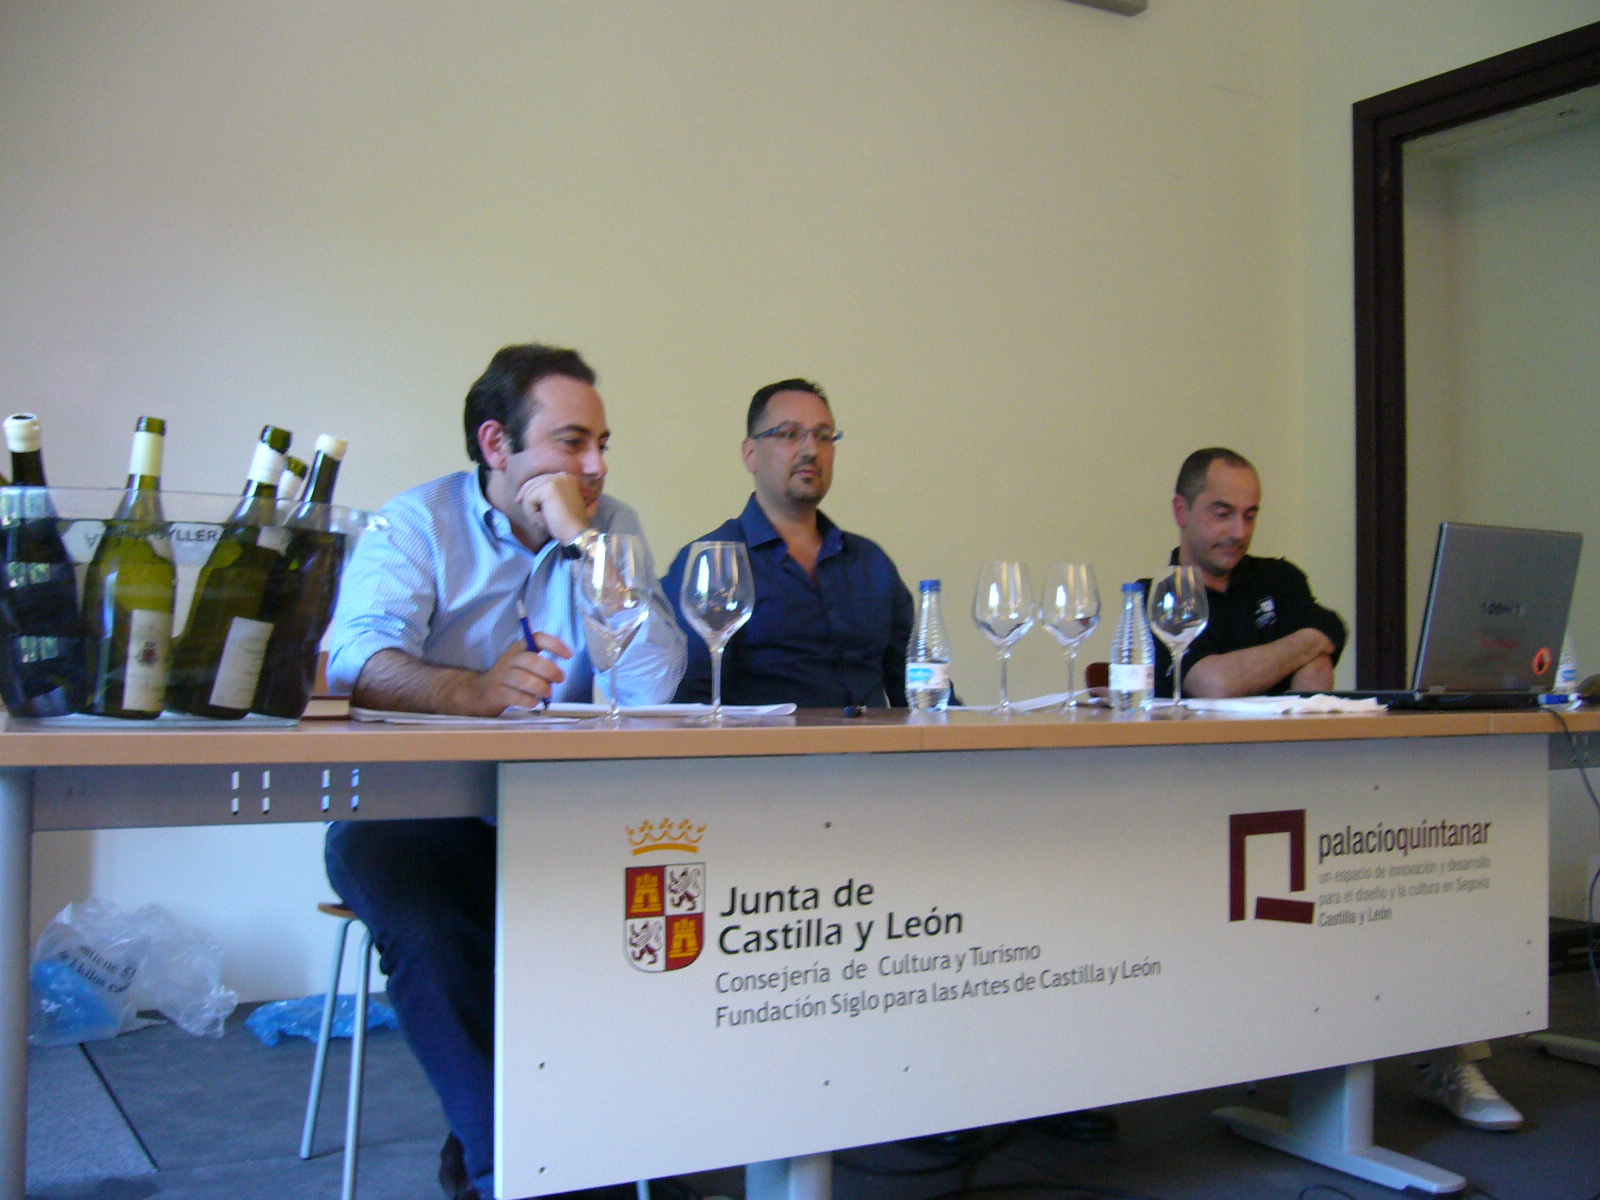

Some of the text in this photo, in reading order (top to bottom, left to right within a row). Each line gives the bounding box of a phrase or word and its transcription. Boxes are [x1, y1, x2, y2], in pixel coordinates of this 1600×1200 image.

[168, 527, 219, 543] YLLER
[1318, 818, 1492, 865] palacioquintanar
[1334, 867, 1372, 884] espacio
[1375, 864, 1386, 879] de
[720, 878, 875, 917] Junta de
[1318, 891, 1341, 907] para
[1356, 886, 1386, 903] diseño
[1408, 881, 1441, 897] cultura
[719, 906, 963, 955] Castilla y León
[1318, 906, 1393, 928] Castilla y León
[715, 943, 1042, 994] Consejería de Cultura y Turismo
[715, 955, 1162, 1028] Fundación Siglo para las Artes de Castilla y León
